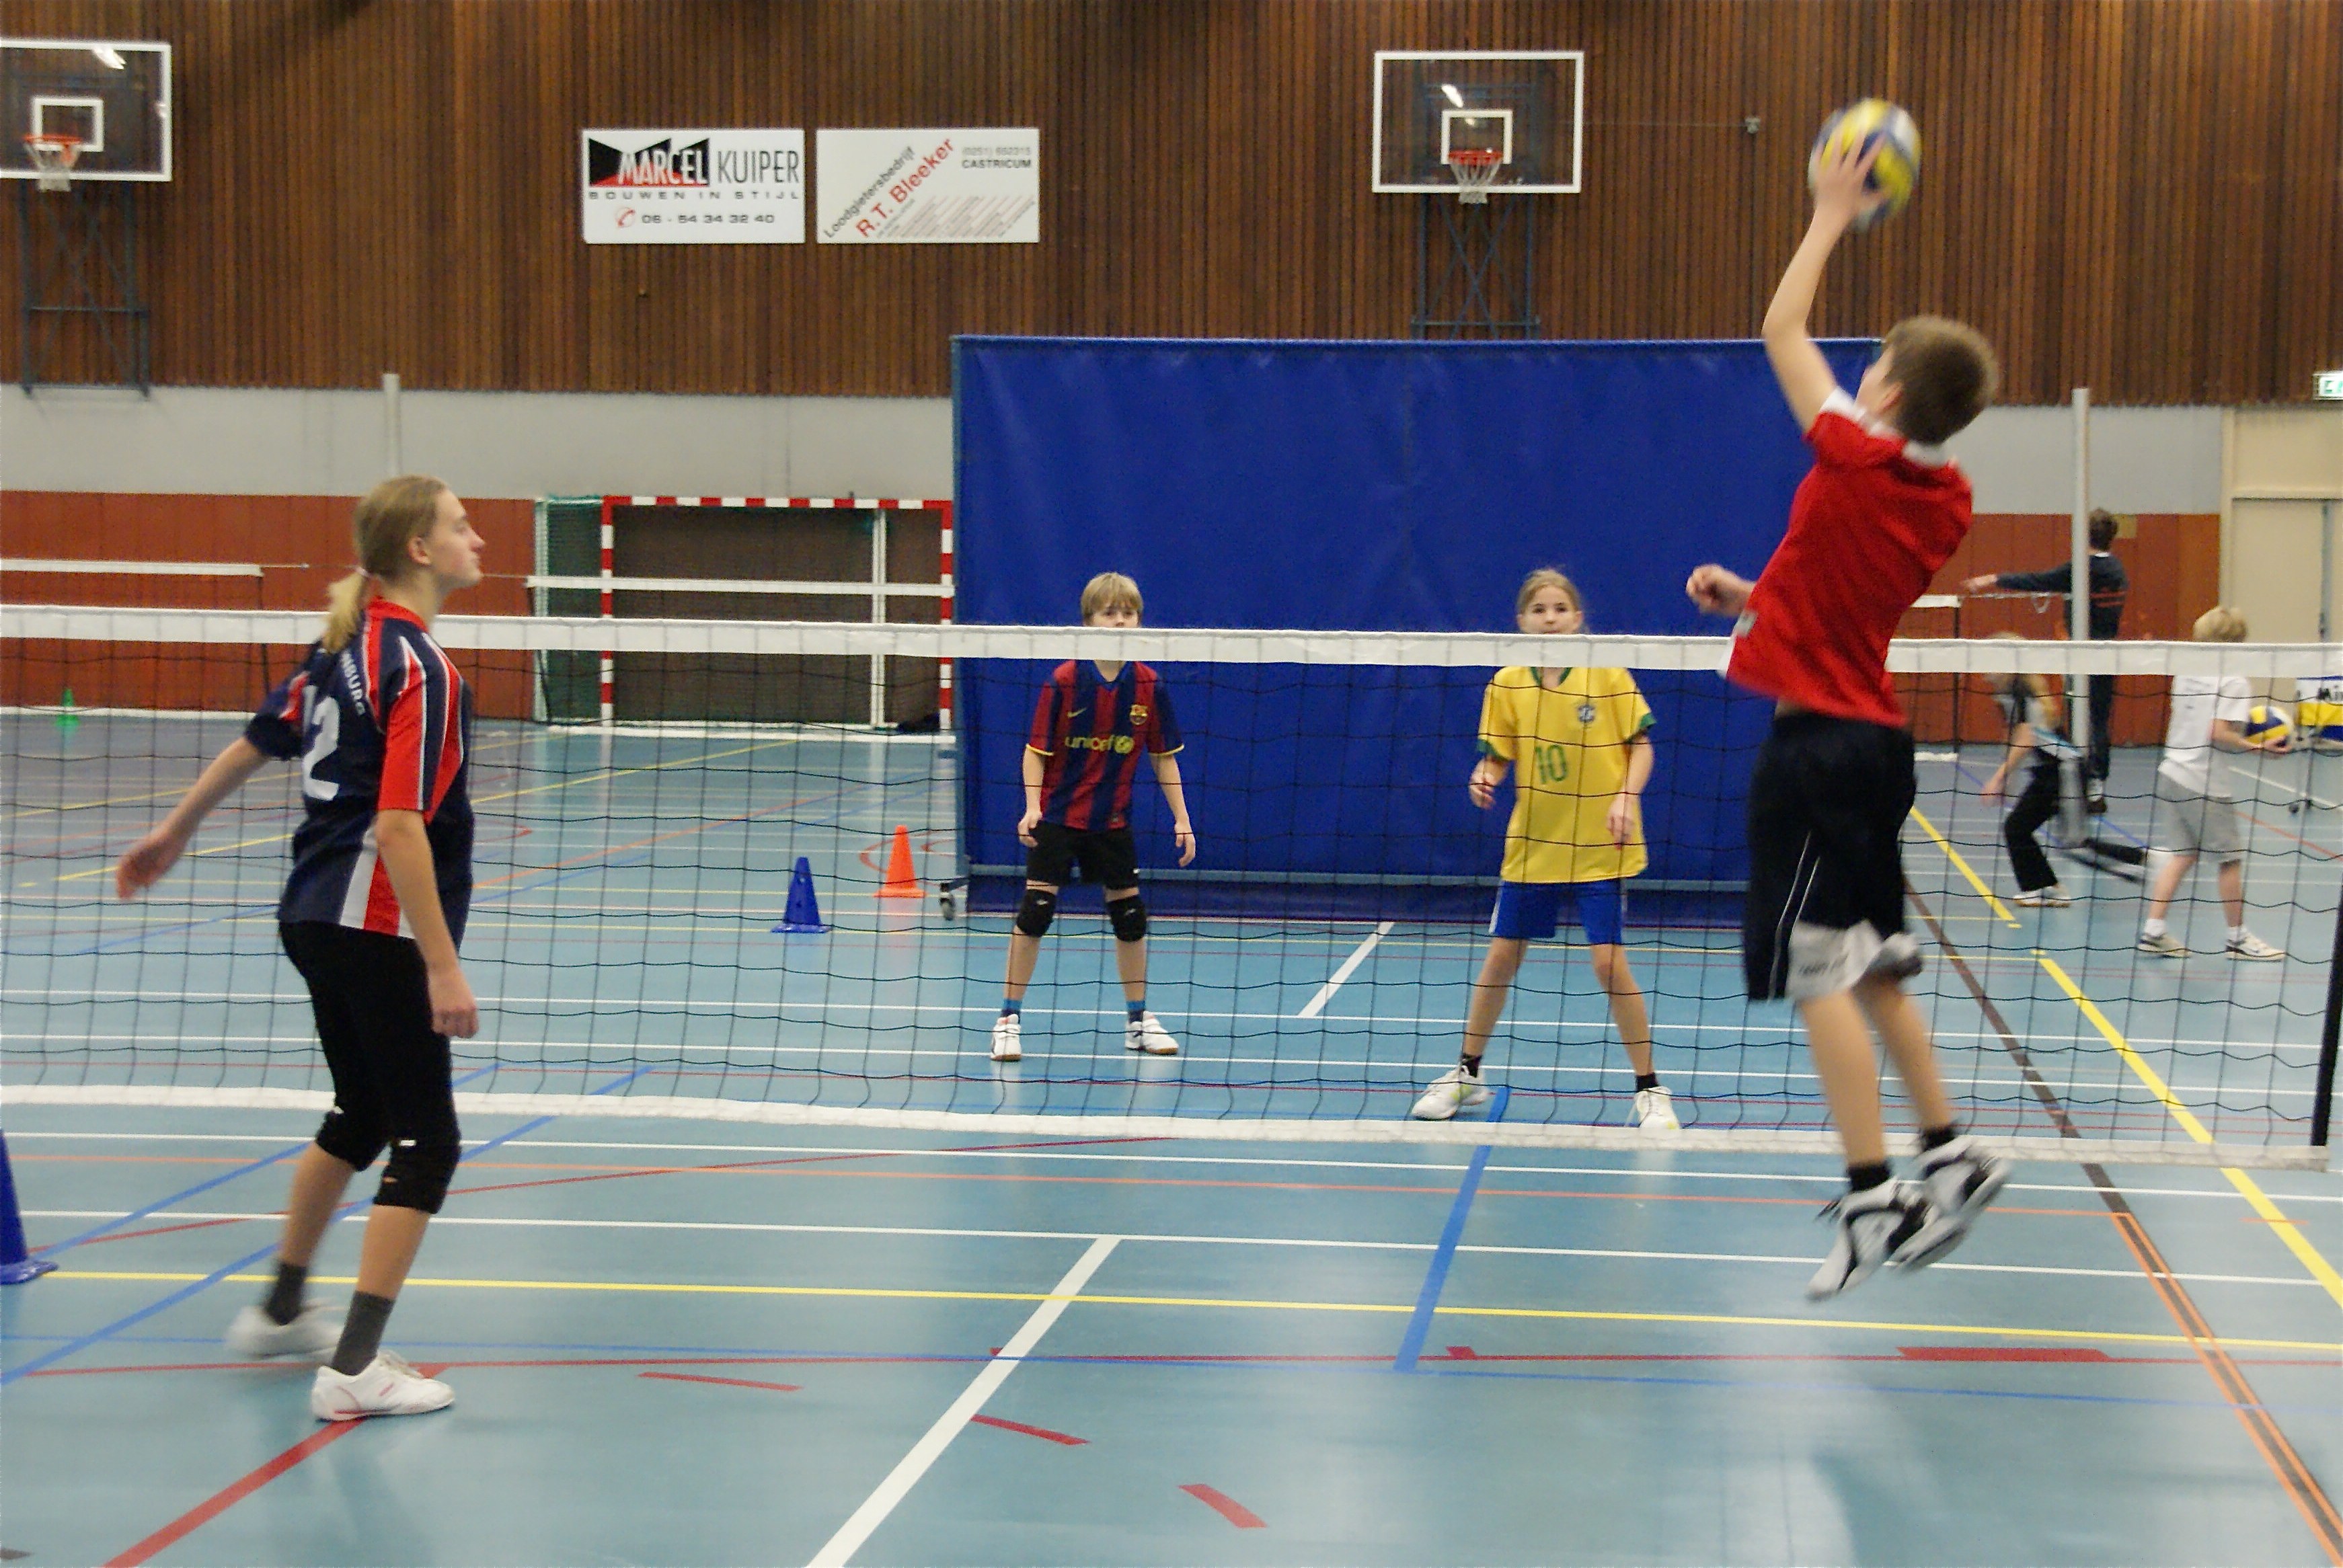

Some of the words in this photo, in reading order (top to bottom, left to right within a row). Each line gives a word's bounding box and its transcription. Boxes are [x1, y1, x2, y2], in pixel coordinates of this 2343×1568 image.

[617, 149, 709, 185] MARCEL
[718, 150, 799, 184] KUIPER
[889, 139, 954, 204] Bleeker
[962, 159, 1031, 169] CASTRICUM
[588, 191, 685, 200] BOUWEN
[699, 191, 721, 200] IN
[734, 191, 799, 200] STIJL
[824, 145, 915, 238] Loodgietersbedrijf
[677, 214, 697, 223] 54
[703, 214, 724, 223] 34
[729, 214, 749, 224] 32
[754, 214, 775, 224] 40
[1065, 734, 1116, 752] unicef
[1535, 744, 1568, 785] 10
